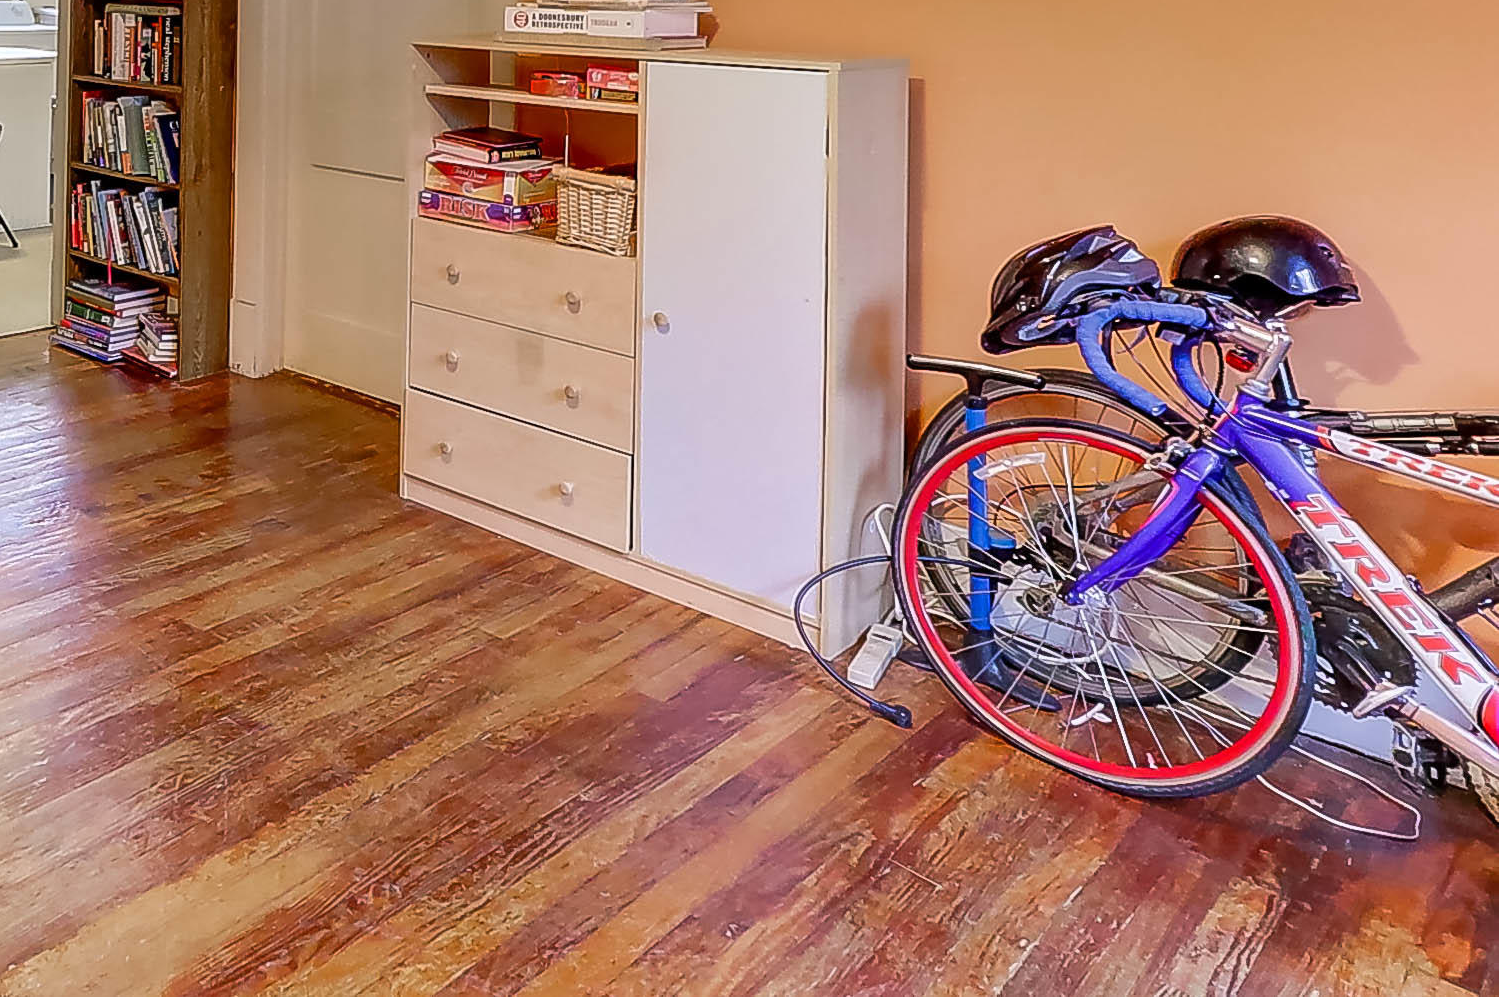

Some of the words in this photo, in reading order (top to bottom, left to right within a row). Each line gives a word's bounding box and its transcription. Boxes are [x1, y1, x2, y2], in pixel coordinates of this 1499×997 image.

[531, 21, 584, 30] RETROSPECTIVE
[538, 13, 584, 22] DOONESBURY
[439, 195, 490, 221] RISK
[1349, 436, 1499, 496] TREK
[1298, 492, 1488, 686] TREK
